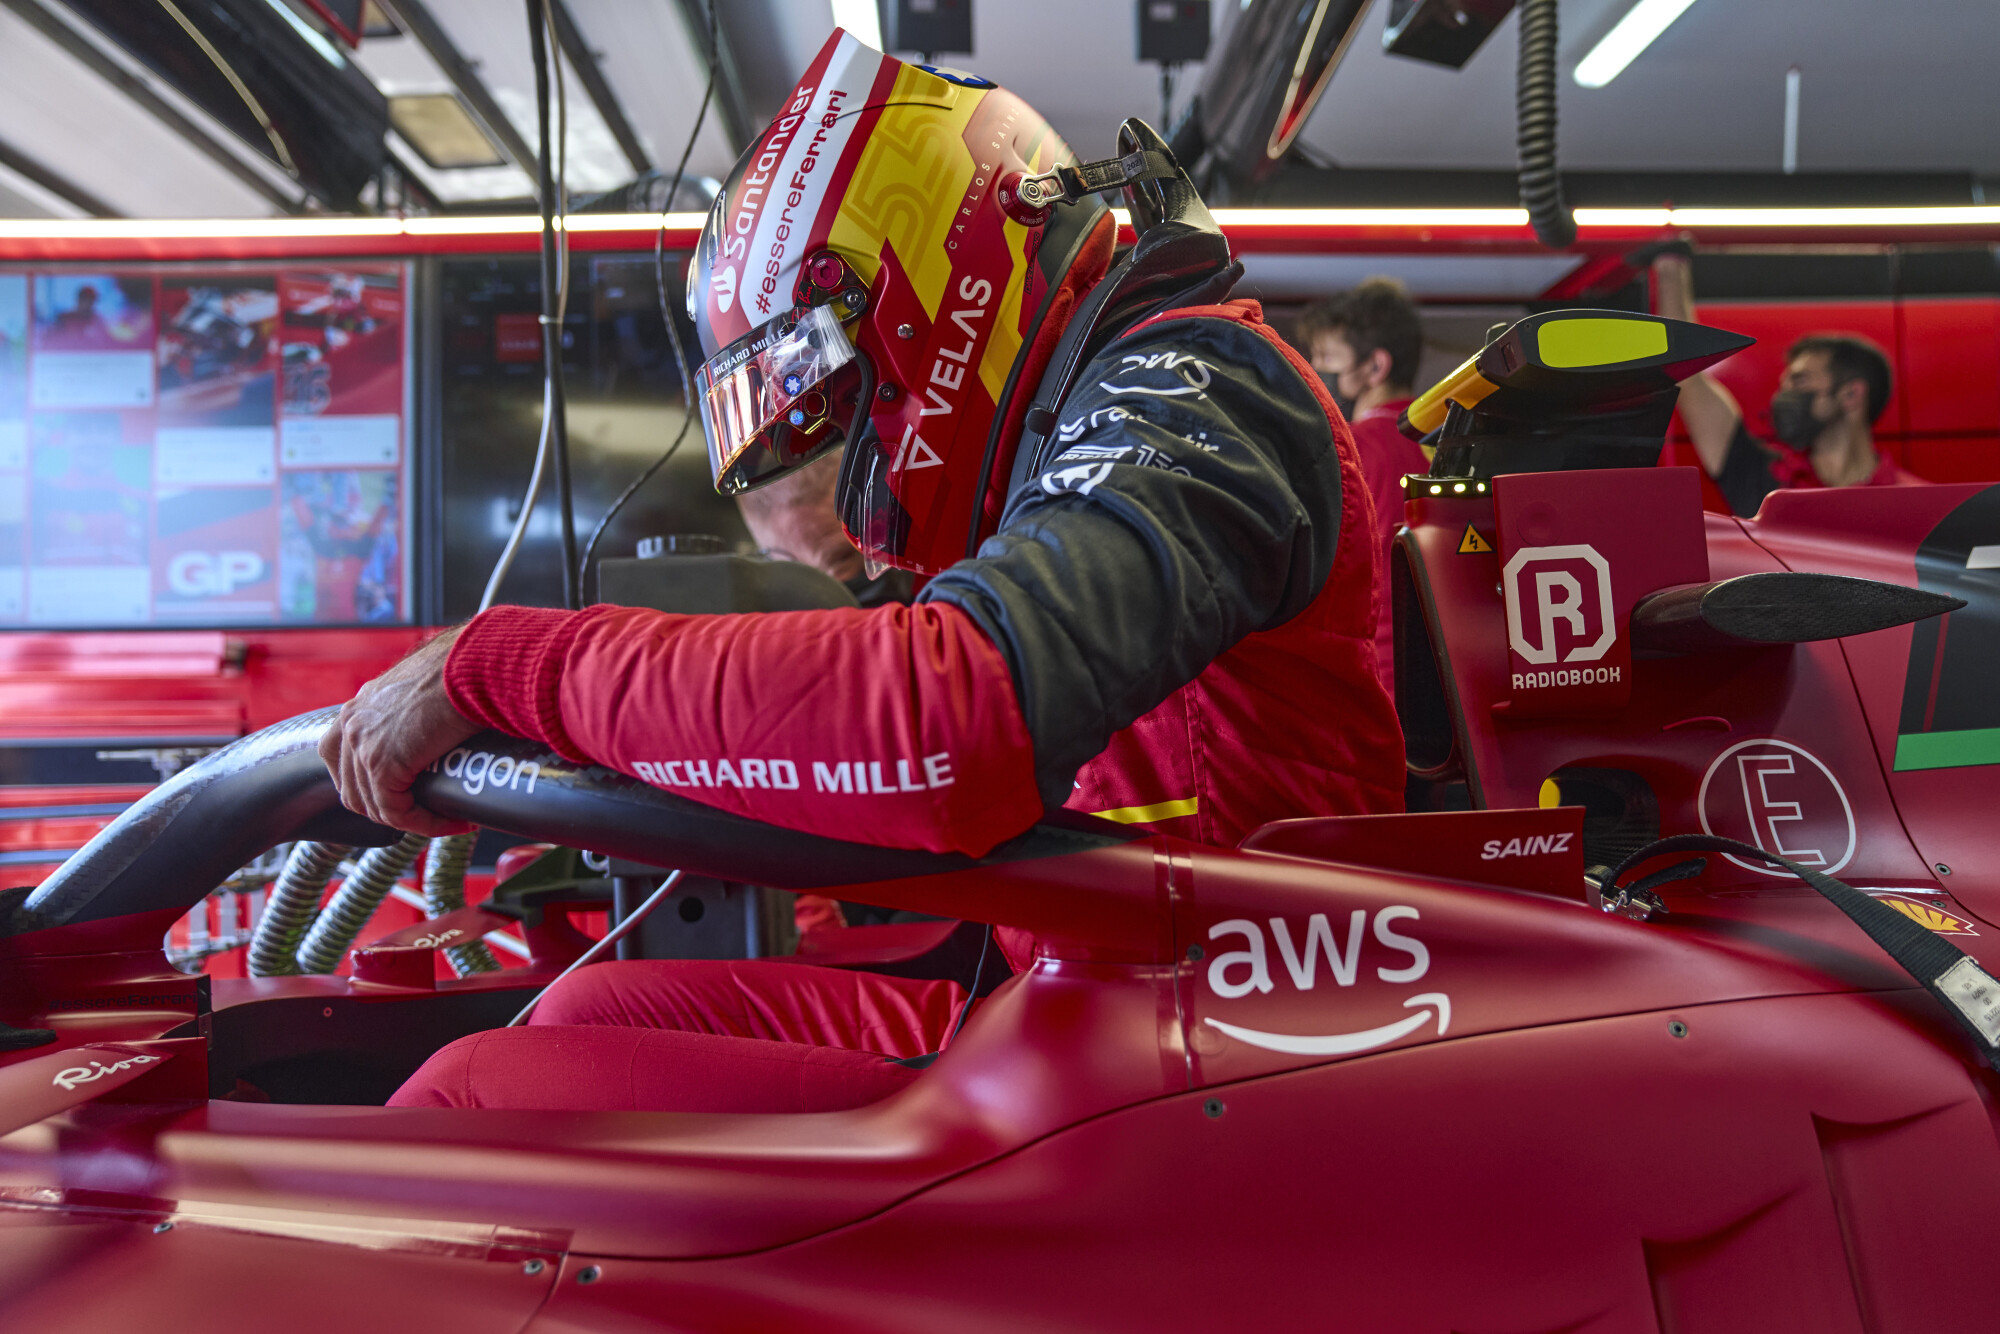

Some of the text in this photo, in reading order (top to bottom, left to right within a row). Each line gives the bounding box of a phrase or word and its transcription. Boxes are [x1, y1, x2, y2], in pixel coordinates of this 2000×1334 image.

[726, 86, 814, 260] Santander
[755, 89, 848, 314] #essereFerrari
[949, 163, 990, 250] CARLOS
[713, 329, 786, 377] RICHARD MILLE
[919, 275, 992, 417] VELAS
[168, 551, 265, 596] GP
[1512, 667, 1621, 689] RADIOBOOK
[631, 752, 955, 794] RICHARD MILLE
[1480, 832, 1574, 860] SAINZ
[1207, 905, 1431, 999] aws
[52, 1054, 161, 1091] Riva
